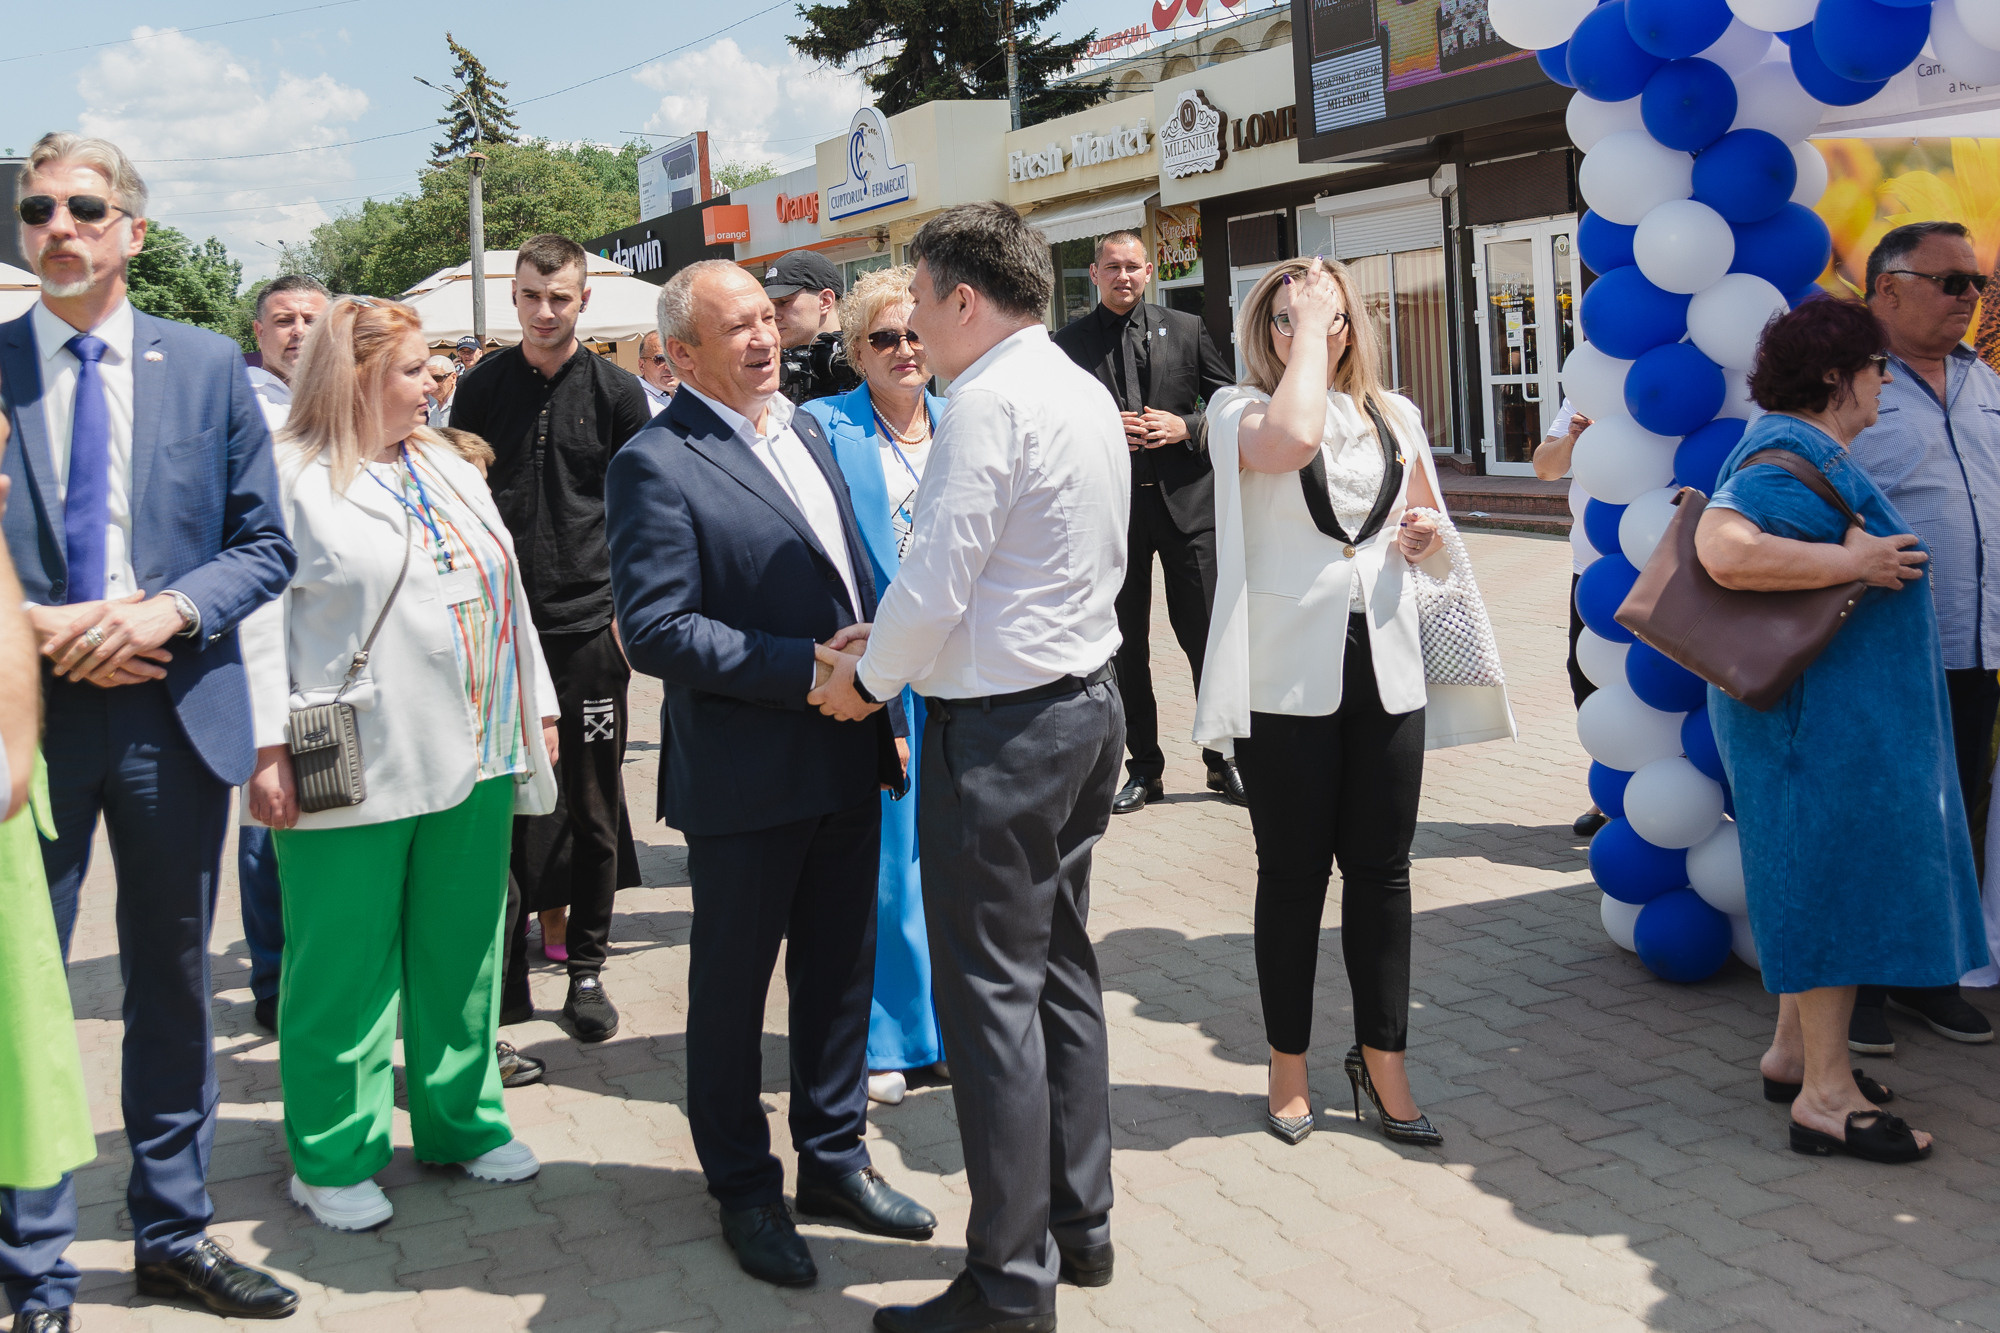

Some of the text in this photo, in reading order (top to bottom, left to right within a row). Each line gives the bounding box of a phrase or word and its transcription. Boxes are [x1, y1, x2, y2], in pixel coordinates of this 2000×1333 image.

[1086, 23, 1151, 57] COMERCIAL
[1327, 91, 1370, 110] MILENIUM
[1949, 82, 1956, 93] a
[1184, 107, 1192, 123] M
[1008, 118, 1151, 183] Fresh Market
[1165, 132, 1216, 158] MILENIUM
[831, 175, 905, 209] CUPTORUL FERMECAT
[776, 191, 820, 223] Orange
[612, 230, 663, 274] darwin
[1163, 242, 1197, 264] Kebab
